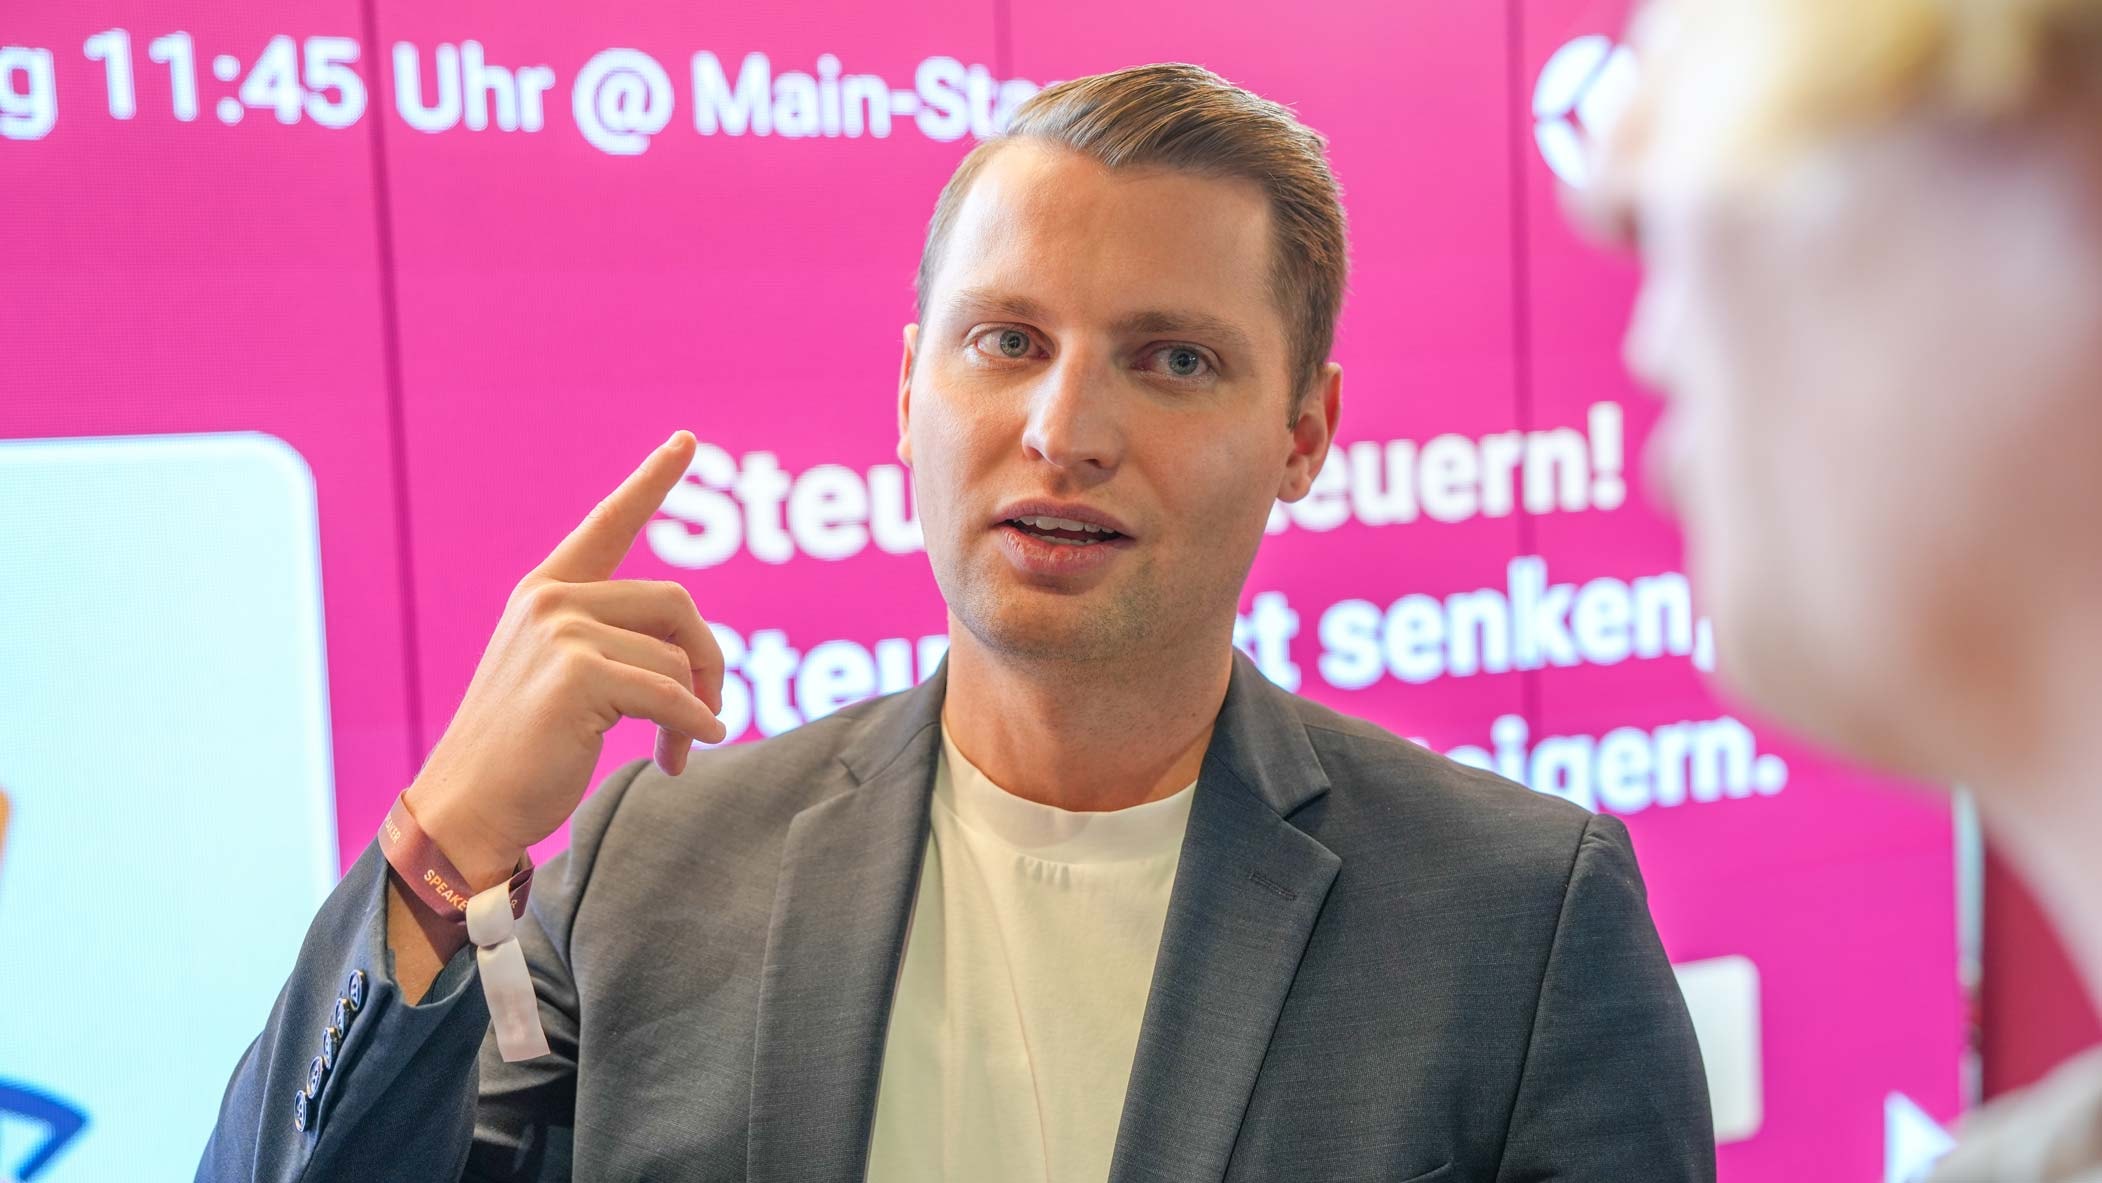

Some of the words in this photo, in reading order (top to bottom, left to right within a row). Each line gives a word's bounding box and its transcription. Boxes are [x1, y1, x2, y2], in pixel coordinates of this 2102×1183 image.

[83, 28, 367, 129] 11:45
[392, 40, 555, 133] Uhr
[571, 47, 674, 155] @
[691, 50, 1062, 141] Main-Sta
[646, 442, 927, 570] Steu
[1264, 400, 1626, 535] euern!
[423, 869, 469, 912] SPEAKE
